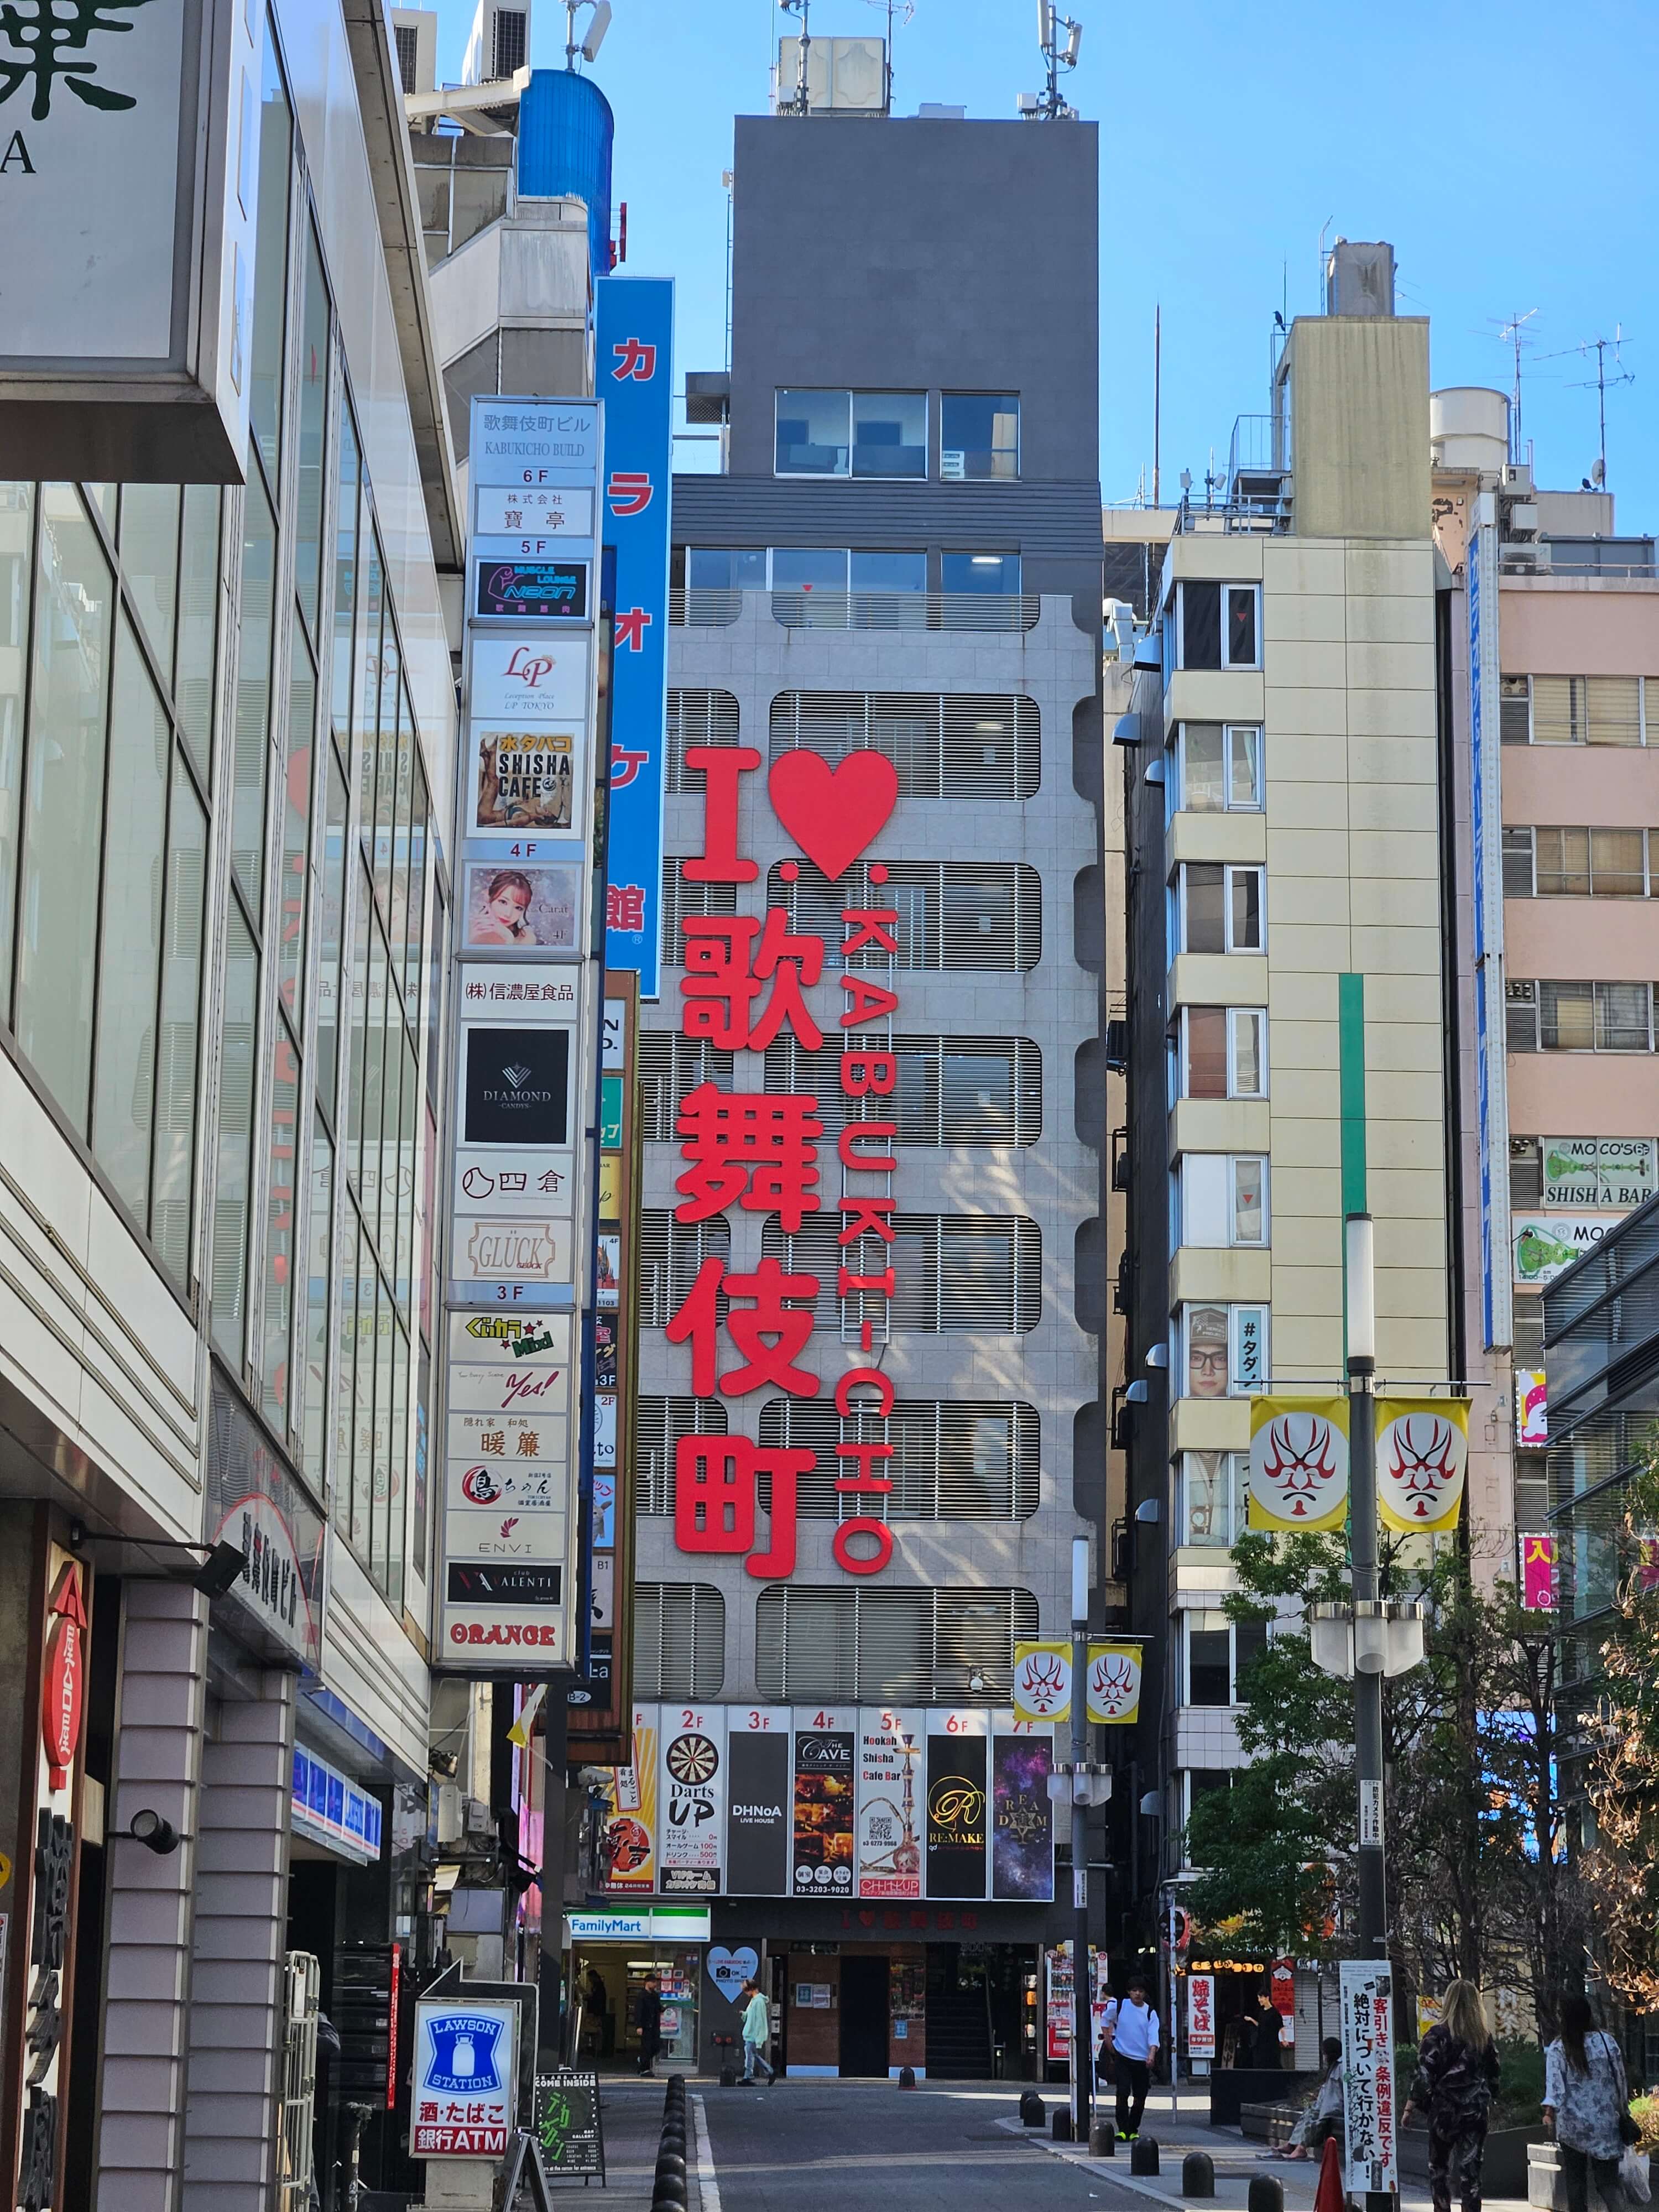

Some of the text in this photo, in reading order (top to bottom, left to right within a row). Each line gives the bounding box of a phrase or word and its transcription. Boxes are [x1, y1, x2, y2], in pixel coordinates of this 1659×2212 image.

[484, 415, 591, 432] 歌舞伎町ビル
[485, 442, 584, 456] KABUKICHO BUILD
[507, 494, 562, 505] 株式会社
[500, 734, 572, 753] 水タバコ
[499, 754, 570, 775] SHISHA
[498, 776, 541, 797] CAFE
[510, 843, 536, 857] 4F
[539, 904, 568, 913] Carat
[483, 1091, 551, 1102] DIAMOND
[499, 1170, 565, 1192] 四倉
[479, 1229, 545, 1268] GLÜCK
[666, 907, 825, 1579] 歌舞伎町
[834, 909, 899, 1574] KABUKI-CHO
[498, 1286, 523, 1300] 3F
[501, 1371, 560, 1408] Yes!
[601, 1397, 615, 1406] 2F
[463, 1417, 529, 1428] 隠れ家 和処
[481, 1431, 540, 1457] 暖簾
[479, 1543, 532, 1553] ENVI
[597, 1561, 608, 1569] B1
[450, 1623, 555, 1646] ORANGE
[681, 1710, 703, 1728] 2F
[748, 1711, 770, 1730] 3F
[812, 1711, 834, 1729] 4F
[880, 1713, 901, 1730] 5F
[946, 1715, 968, 1733] 6F
[863, 1736, 897, 1746] Hookah
[863, 1753, 894, 1764] Shisha
[863, 1771, 901, 1782] Cafe Bar
[671, 1784, 714, 1798] Darts
[669, 1798, 714, 1828] UP
[733, 1805, 782, 1818] DHNoA
[929, 1833, 984, 1844] RE:MAKE
[572, 1919, 641, 1933] FamilyMart
[1192, 1979, 1211, 2032] 焼そば
[433, 2020, 497, 2036] LAWSON
[431, 2074, 493, 2090] STATION
[1373, 1997, 1393, 2168] 客引き条例違反です
[418, 2129, 504, 2151] 銀行ATM
